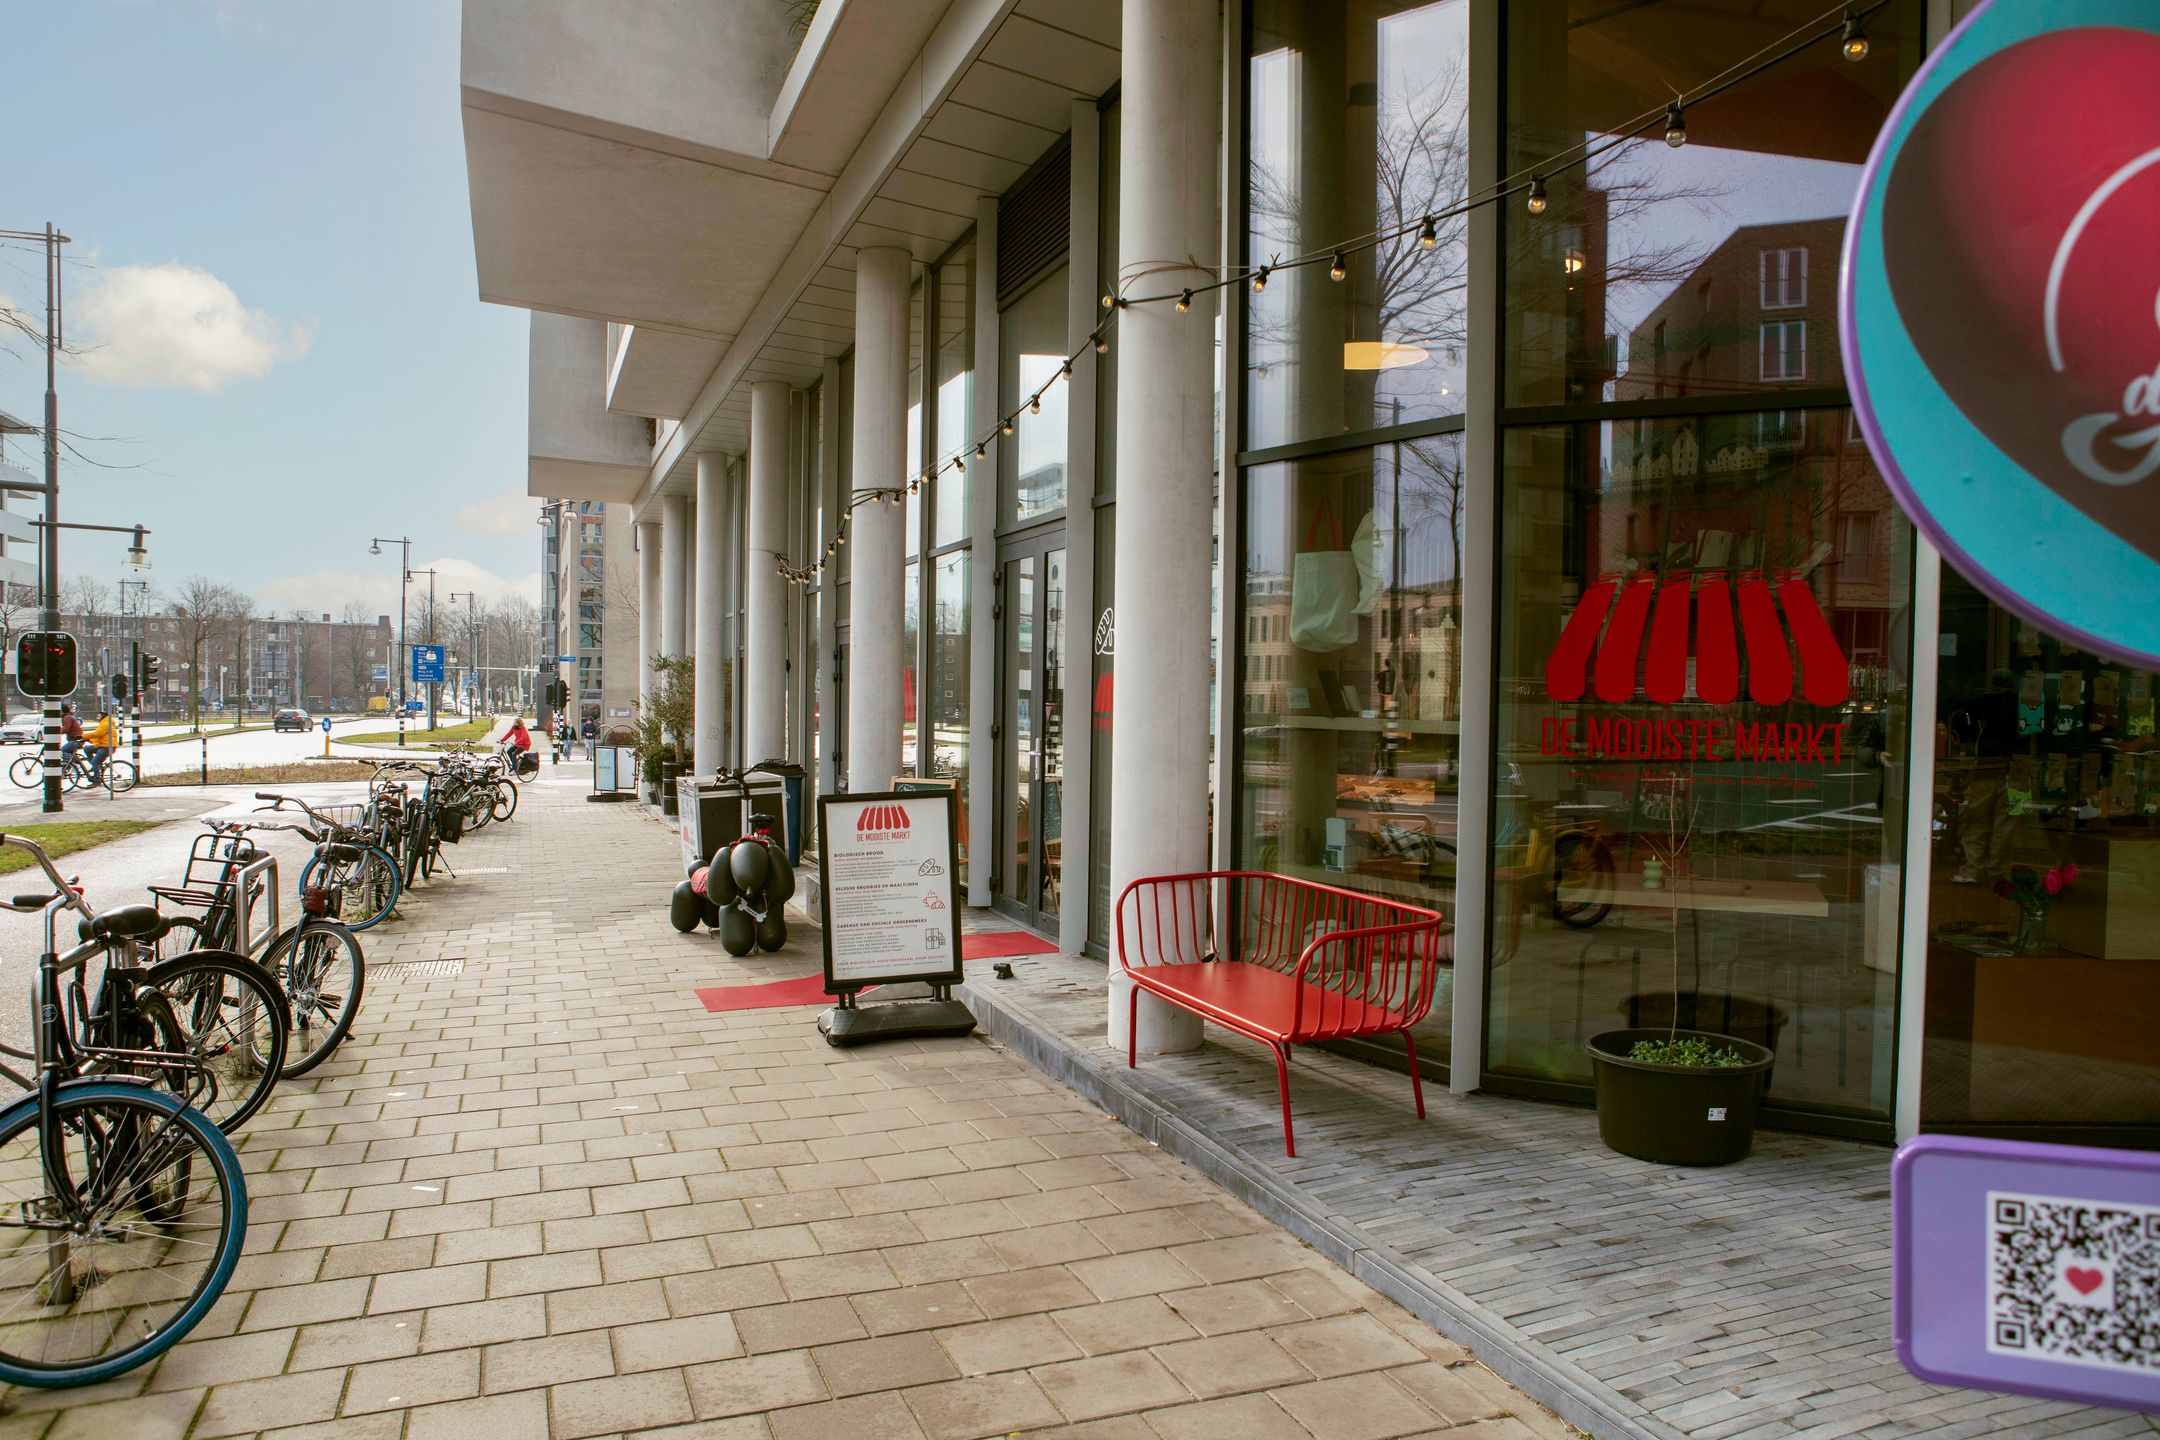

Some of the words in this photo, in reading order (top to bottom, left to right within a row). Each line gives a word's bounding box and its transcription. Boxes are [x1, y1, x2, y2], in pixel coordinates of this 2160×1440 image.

[1541, 717, 1576, 757] DE
[1588, 718, 1722, 761] MOOISTE
[1735, 722, 1849, 765] MARKT
[866, 832, 890, 841] MOOISTE
[892, 831, 910, 840] MARKT
